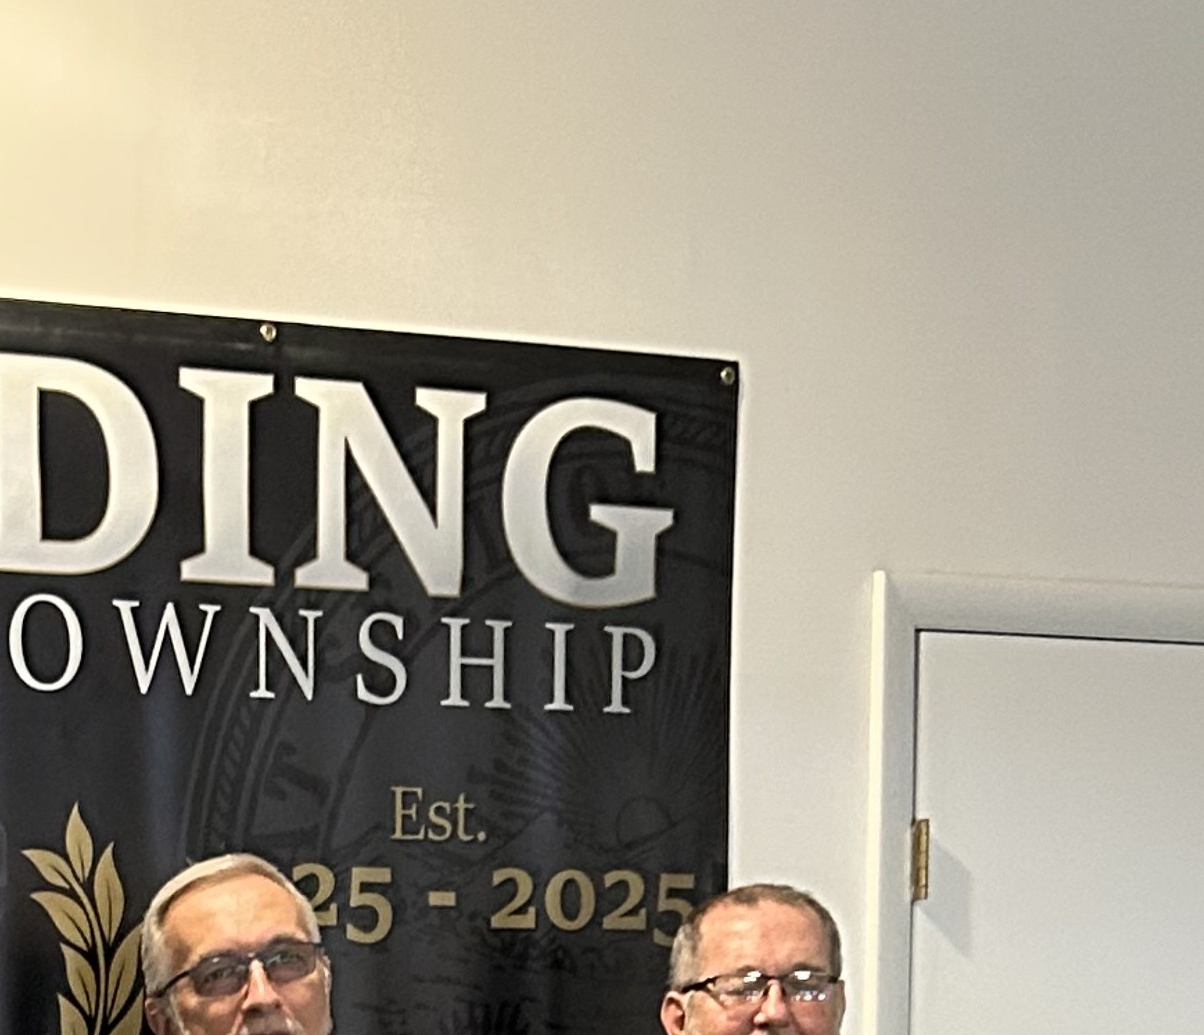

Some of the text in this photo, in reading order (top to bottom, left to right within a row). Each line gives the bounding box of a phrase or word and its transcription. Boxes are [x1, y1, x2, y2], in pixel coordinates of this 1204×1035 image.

[390, 786, 487, 842] Est.
[293, 862, 393, 943] 25
[490, 867, 695, 947] 2025
